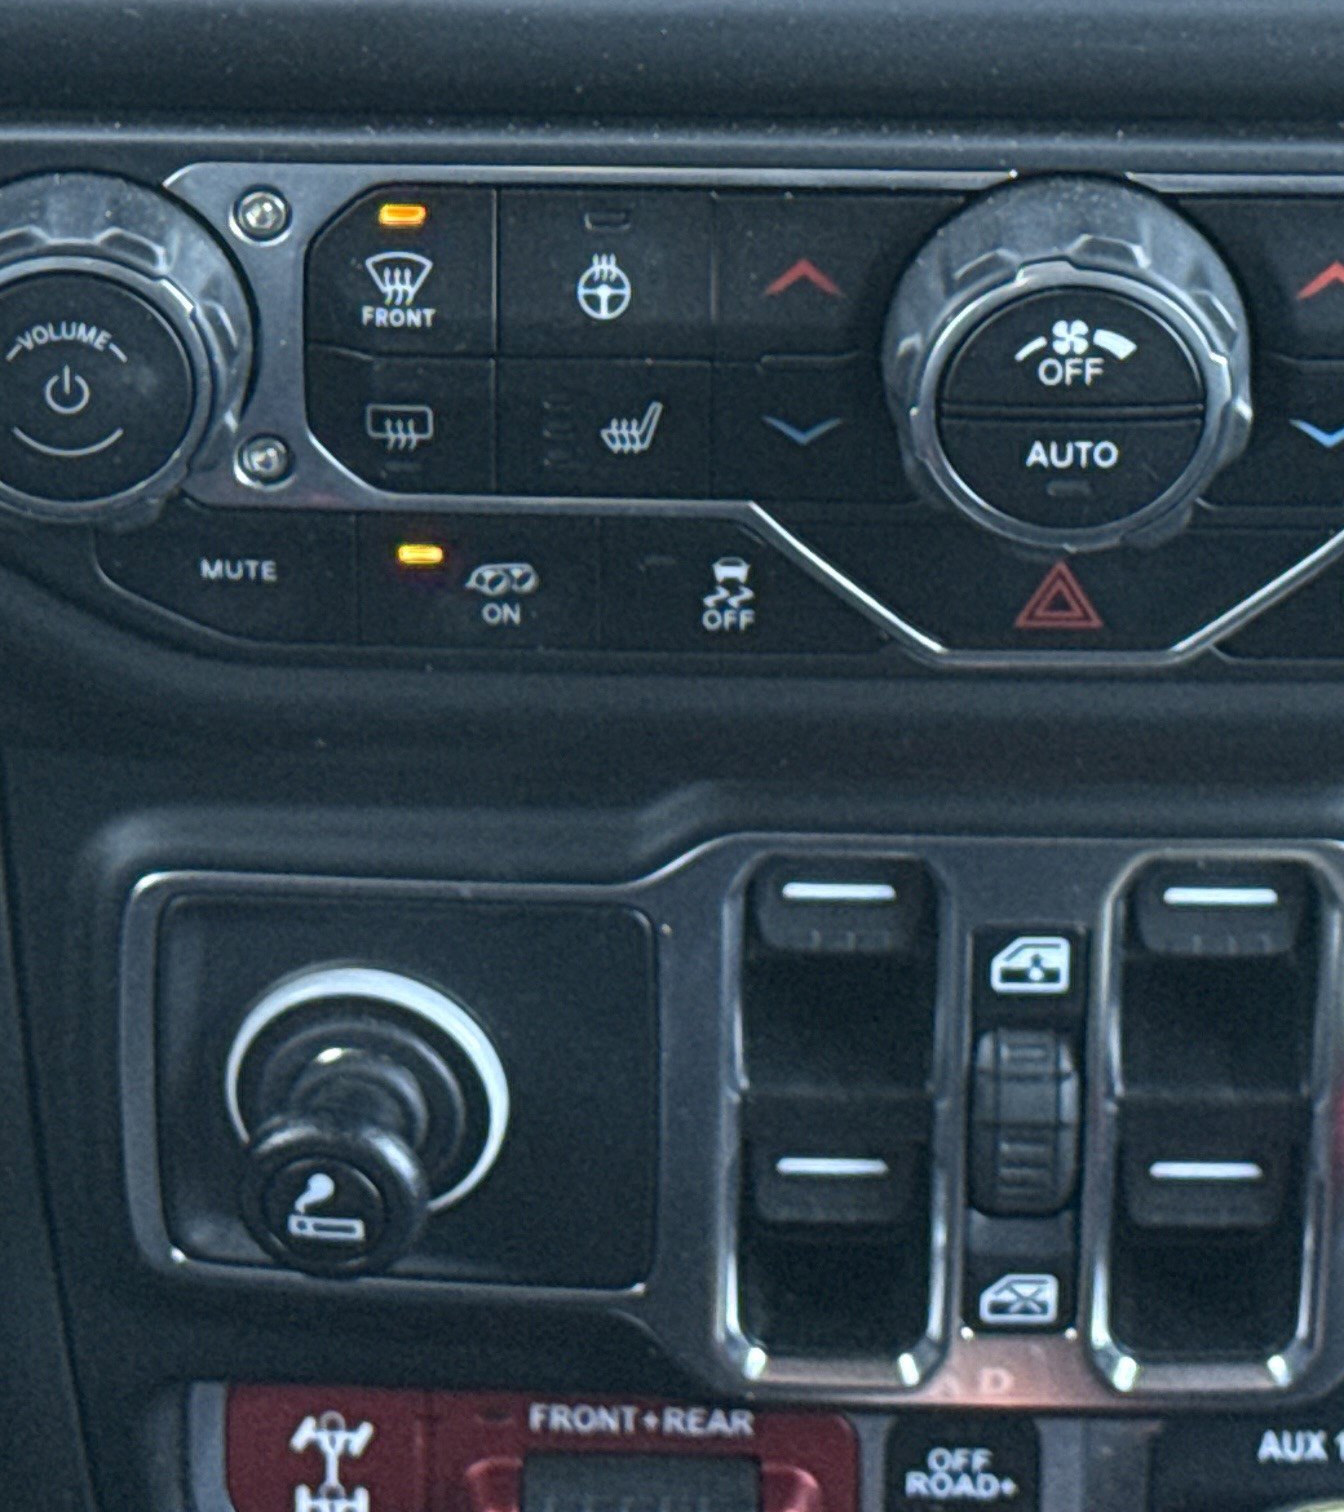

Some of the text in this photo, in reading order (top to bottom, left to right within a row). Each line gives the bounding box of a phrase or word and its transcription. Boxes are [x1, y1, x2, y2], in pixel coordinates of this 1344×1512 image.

[361, 304, 436, 328] FRONT
[15, 320, 113, 352] VOLUME
[1036, 356, 1104, 387] OFF
[1024, 439, 1120, 469] AUTO
[199, 558, 276, 581] MUTE
[481, 601, 522, 625] ON
[701, 607, 755, 631] OFF
[926, 1446, 990, 1476] OFF
[1257, 1429, 1328, 1463] AUX
